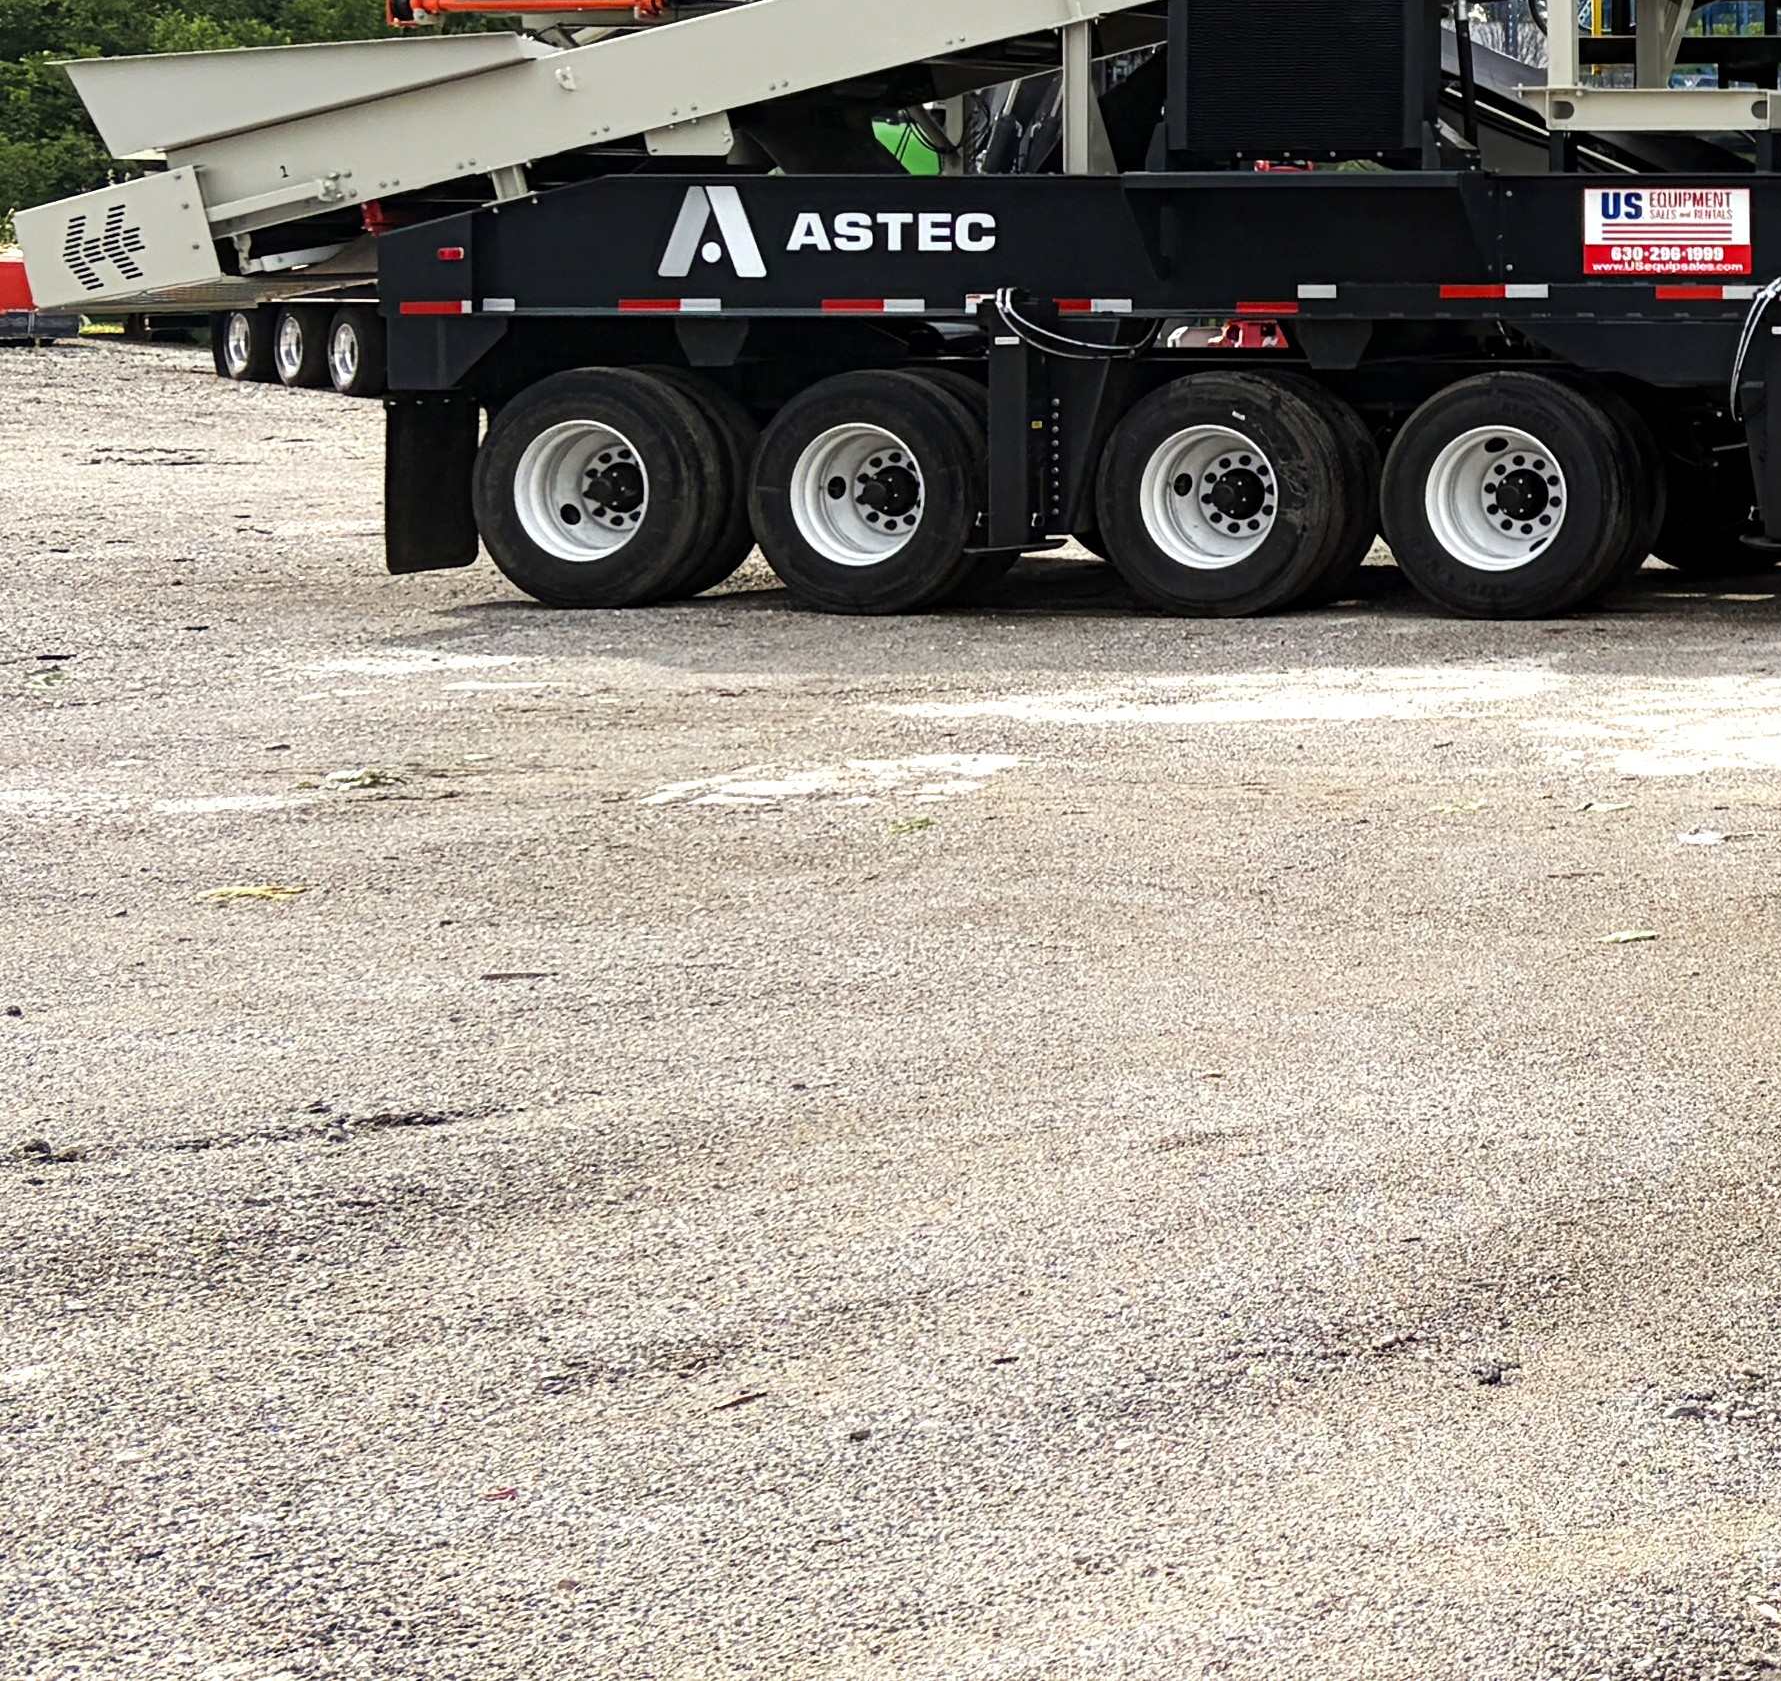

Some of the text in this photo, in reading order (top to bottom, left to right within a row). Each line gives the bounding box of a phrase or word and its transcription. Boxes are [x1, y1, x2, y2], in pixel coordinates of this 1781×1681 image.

[1601, 191, 1732, 220] US EQUIPMENT
[1650, 209, 1677, 219] SALES
[1694, 209, 1733, 220] RENTALS
[785, 212, 997, 252] ASTEC
[1592, 261, 1744, 273] www.USequipsales.com
